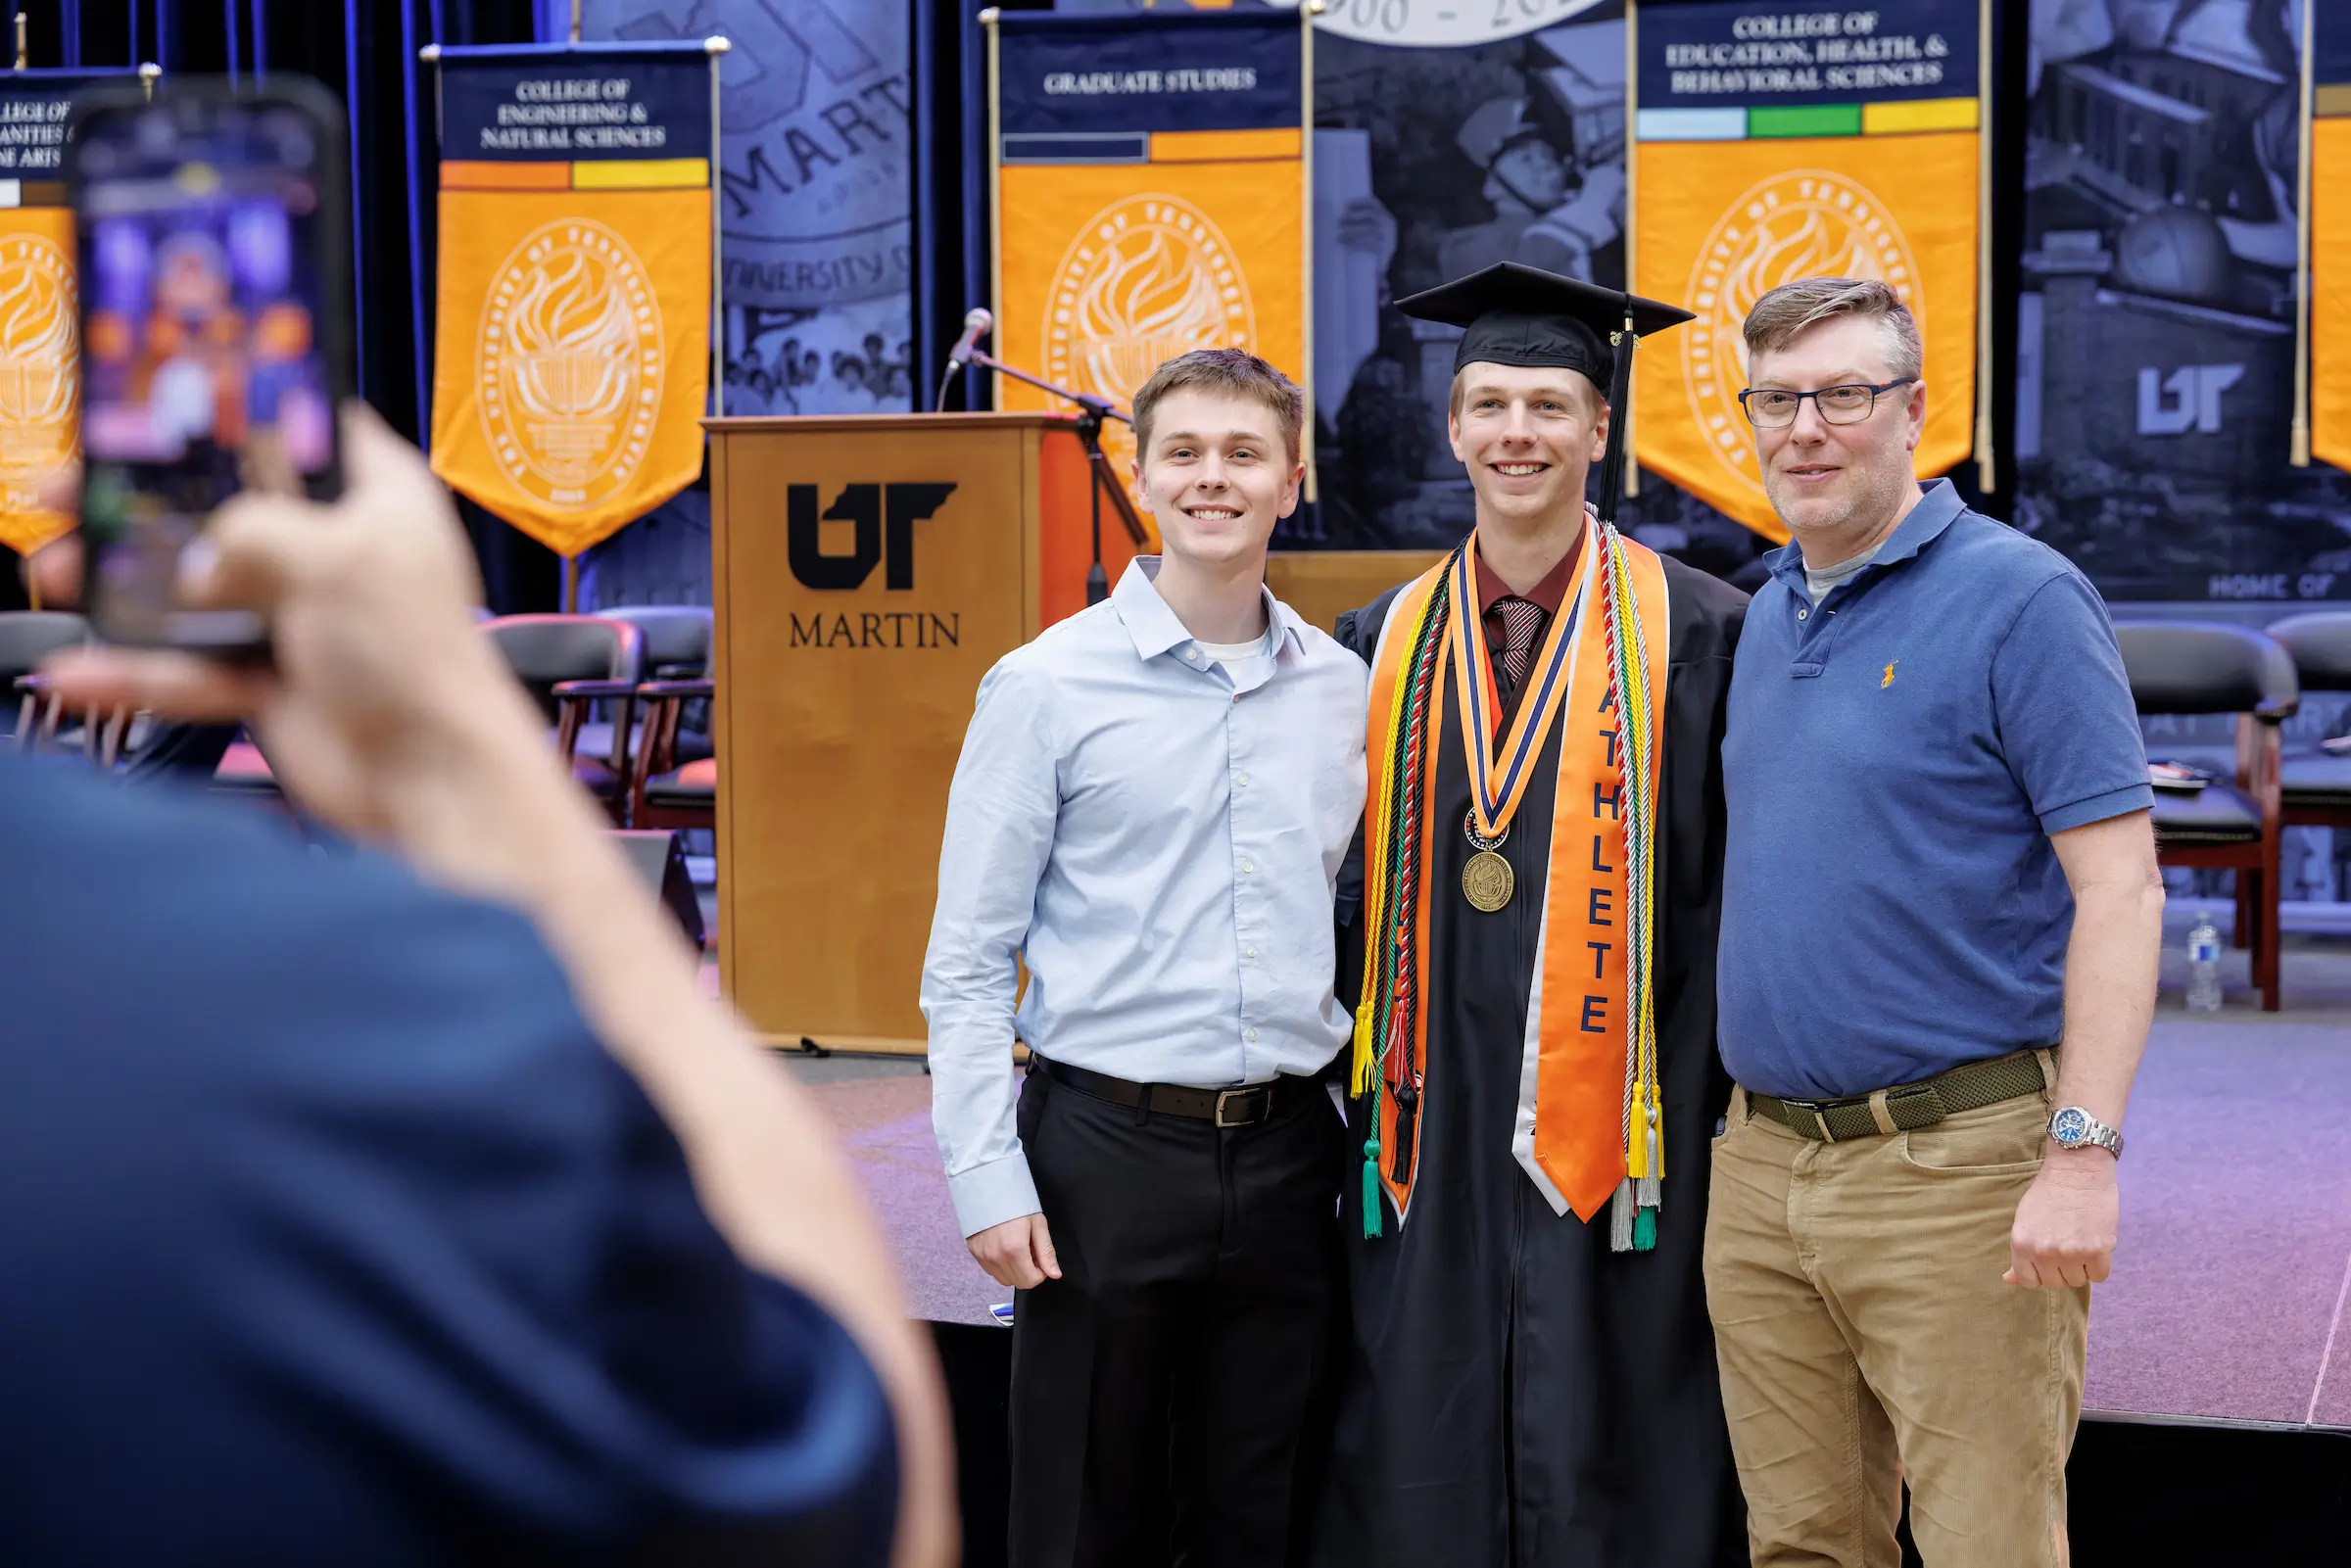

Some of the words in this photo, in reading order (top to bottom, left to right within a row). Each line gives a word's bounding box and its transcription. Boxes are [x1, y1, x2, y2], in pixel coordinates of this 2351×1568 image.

[1732, 13, 1843, 40] COLLEGE
[1844, 11, 1880, 35] OF
[1665, 40, 1814, 68] EDUCATION,
[1924, 33, 1949, 58] &
[515, 80, 600, 103] COLLEGE
[601, 78, 631, 101] OF
[1043, 71, 1163, 95] GRADUATE
[1164, 68, 1257, 93] STUDIES
[1671, 67, 1823, 94] BEHAVIORAL
[1825, 61, 1944, 90] SCIENCES
[46, 101, 72, 122] OF
[497, 103, 628, 126] ENGINEERING
[629, 102, 648, 124] &
[480, 127, 572, 149] NATURAL
[574, 125, 666, 148] SCIENCES
[19, 147, 61, 167] ARTS
[2137, 362, 2246, 435] UT
[787, 482, 958, 592] UT
[2208, 573, 2290, 599] HOME
[2297, 573, 2337, 598] OF
[789, 611, 961, 649] MARTIN
